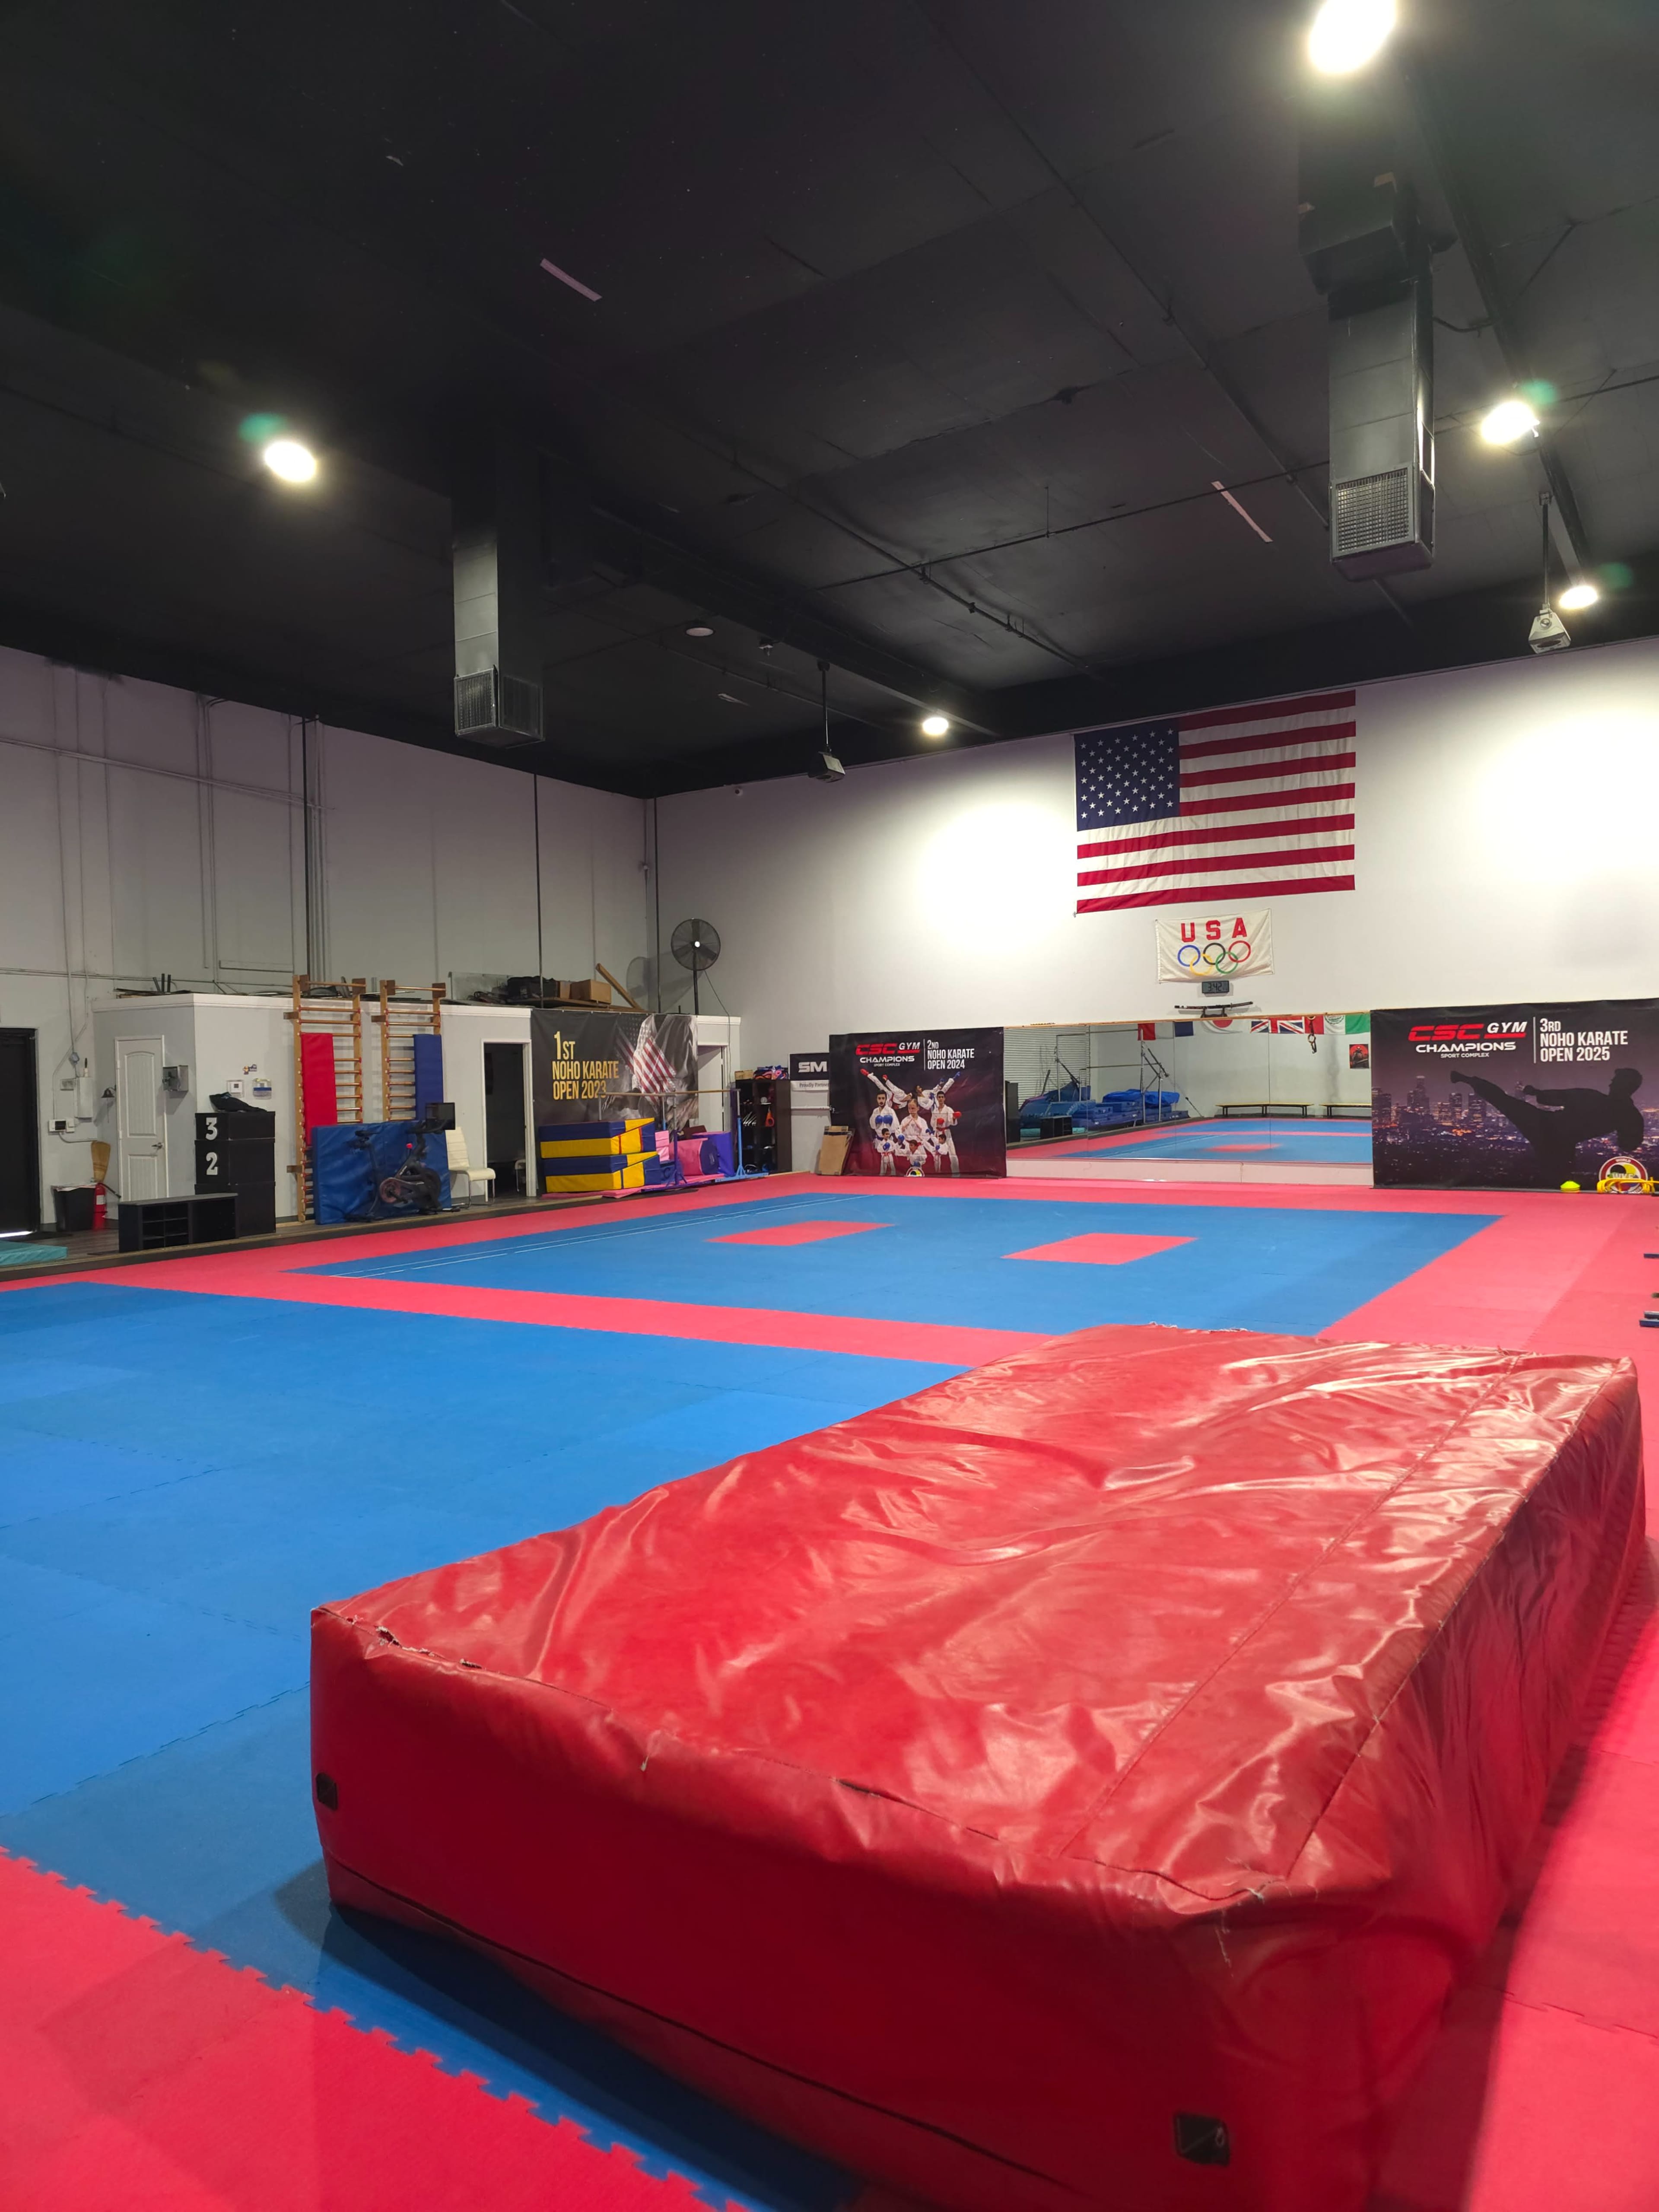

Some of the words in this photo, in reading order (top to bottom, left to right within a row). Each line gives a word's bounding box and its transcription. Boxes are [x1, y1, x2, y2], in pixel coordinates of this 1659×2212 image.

[1181, 917, 1247, 943] USA
[1408, 1023, 1484, 1041] CSC
[1486, 1021, 1528, 1033] GYM
[1539, 1018, 1561, 1032] 3RD
[554, 1031, 575, 1060] 1ST
[927, 1039, 939, 1049] 2ND
[1540, 1033, 1574, 1047] NOHO
[1577, 1030, 1628, 1046] KARATE
[855, 1043, 897, 1055] CSC
[899, 1042, 920, 1050] GYM
[927, 1049, 946, 1059] NOHO
[947, 1048, 975, 1059] KARATE
[1416, 1042, 1516, 1052] CHAMPIONS
[1540, 1047, 1573, 1062] OPEN
[1576, 1046, 1610, 1061] 2025
[552, 1061, 580, 1080] NOHO
[582, 1061, 619, 1079] KARATE
[798, 1061, 827, 1073] SM
[928, 1059, 945, 1070] OPEN
[947, 1059, 965, 1069] 2024
[553, 1081, 579, 1100] OPEN
[582, 1080, 606, 1099] 2023
[205, 1117, 217, 1140] 3
[206, 1152, 218, 1175] 2
